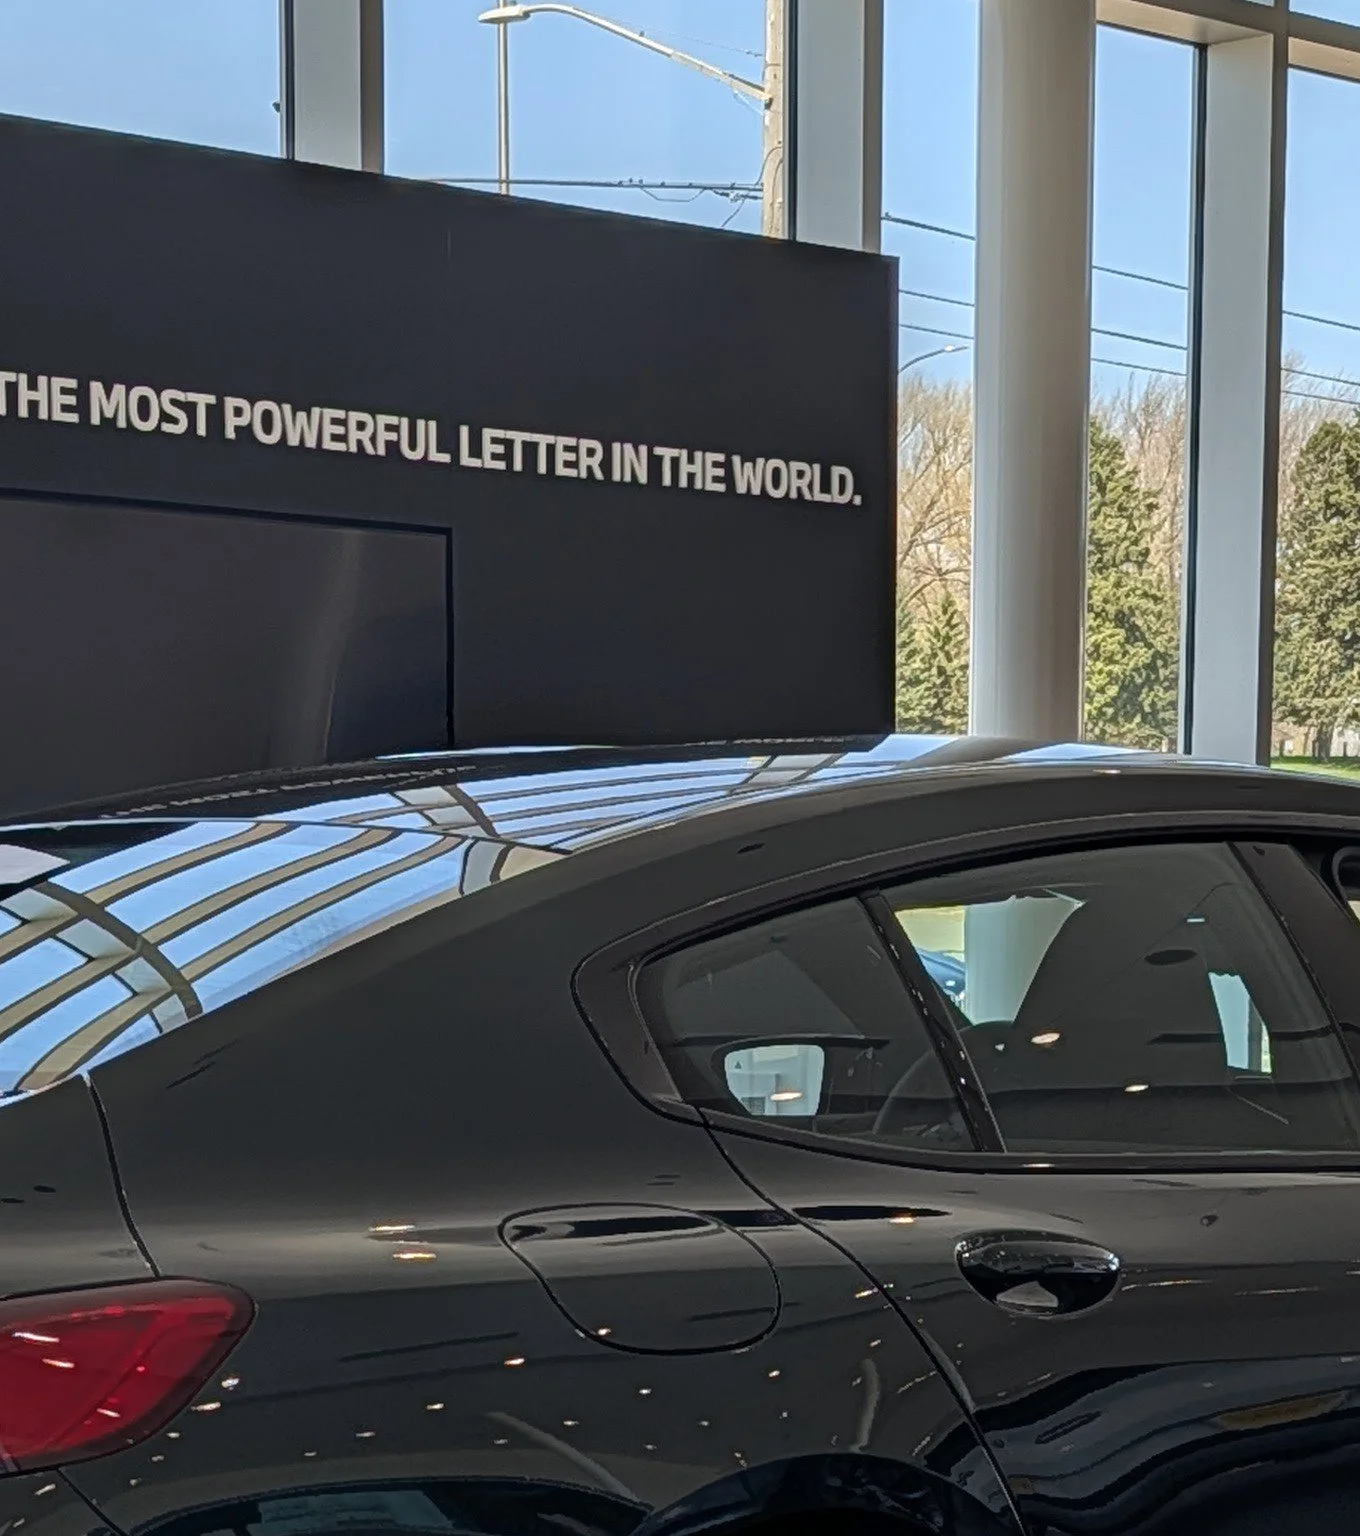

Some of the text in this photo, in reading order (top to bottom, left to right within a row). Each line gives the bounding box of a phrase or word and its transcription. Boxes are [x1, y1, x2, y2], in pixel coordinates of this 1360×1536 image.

[90, 380, 217, 437] MOST
[223, 396, 451, 463] POWERFUL
[459, 425, 604, 480] LETTER
[612, 441, 648, 485] IN
[653, 446, 727, 493] THE
[731, 454, 862, 505] WORLD.
